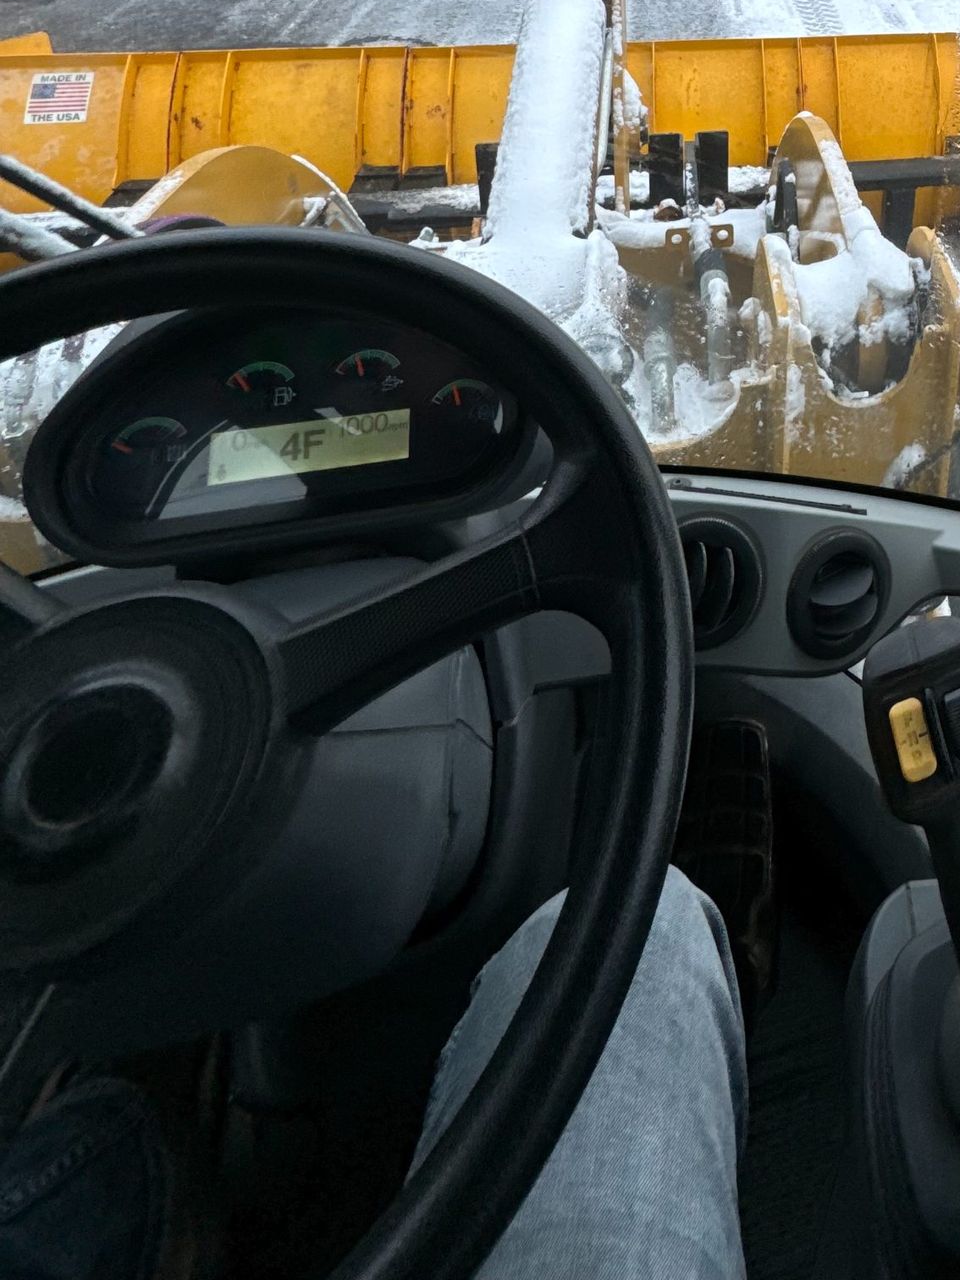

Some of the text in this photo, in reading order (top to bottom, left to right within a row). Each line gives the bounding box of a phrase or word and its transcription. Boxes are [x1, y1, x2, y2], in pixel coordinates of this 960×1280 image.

[40, 74, 72, 82] MADE
[31, 113, 81, 122] THE USA
[279, 429, 326, 461] 4F
